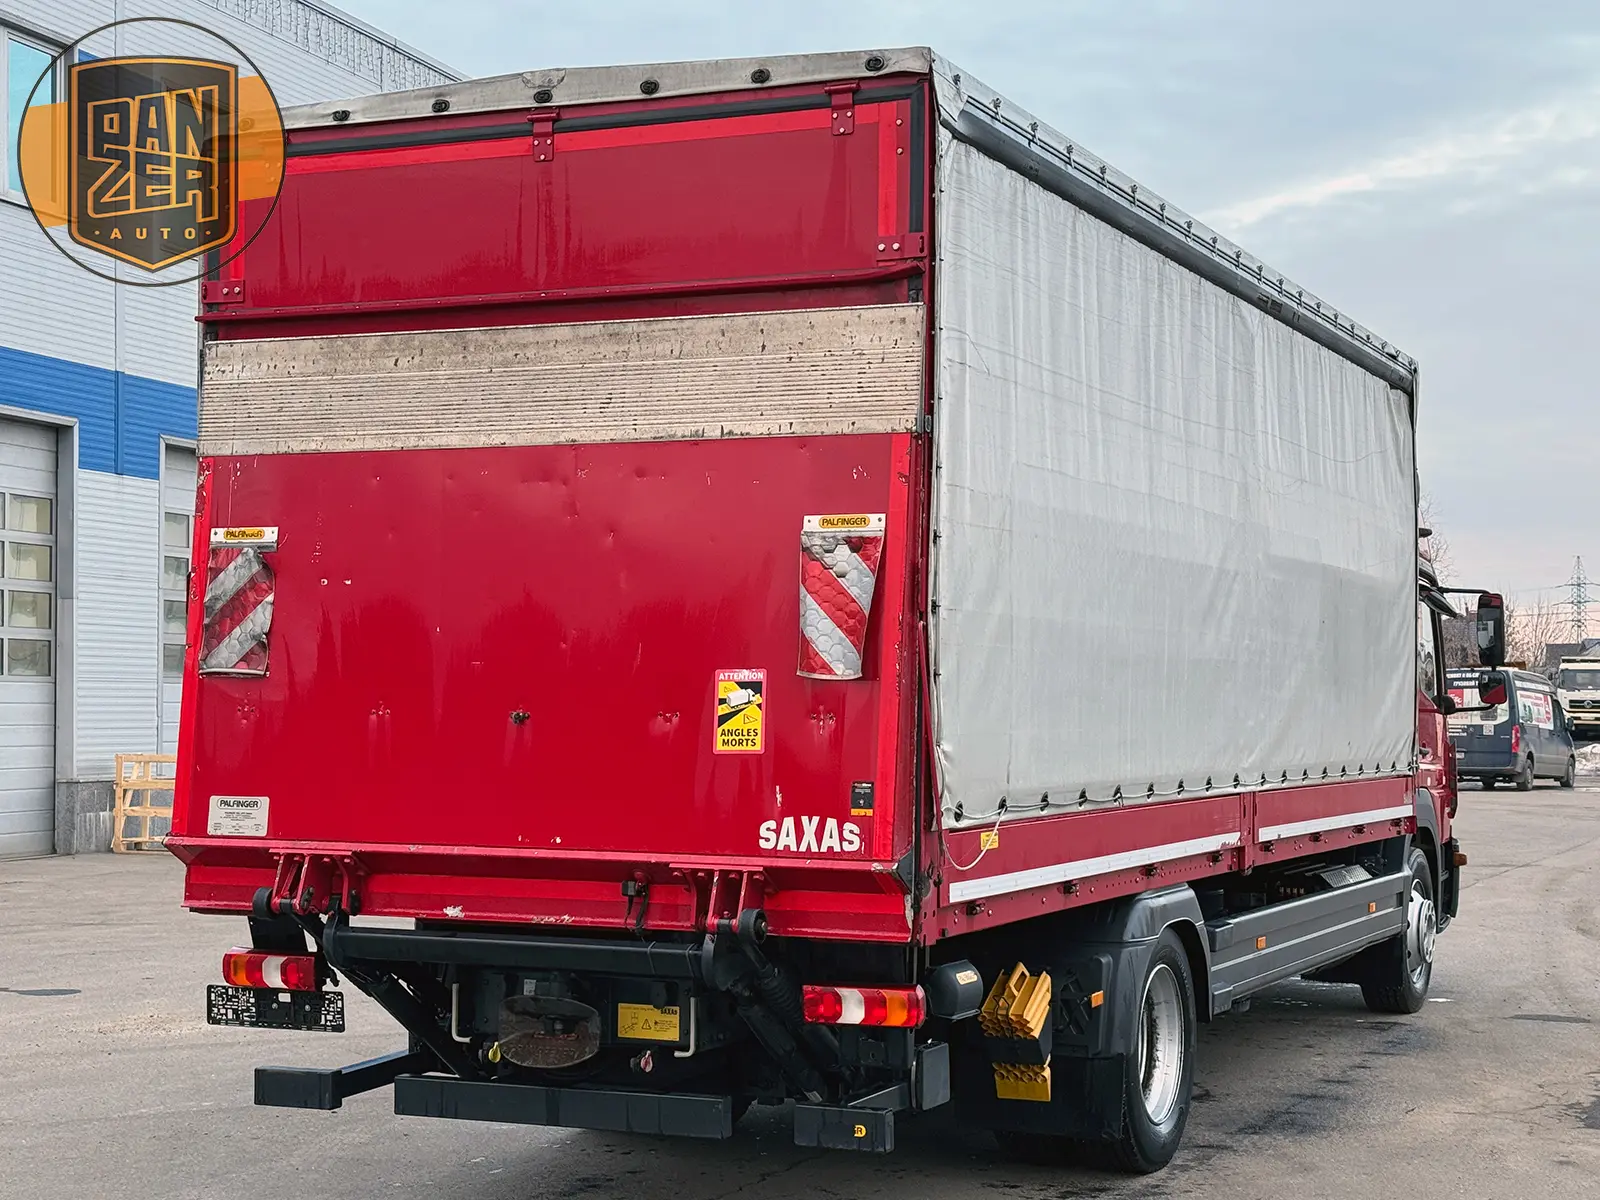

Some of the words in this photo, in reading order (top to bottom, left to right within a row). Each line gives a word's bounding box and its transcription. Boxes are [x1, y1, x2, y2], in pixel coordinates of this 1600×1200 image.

[821, 517, 867, 526] PALFINGER
[718, 672, 764, 681] ATTENTION
[720, 728, 758, 737] ANGLES
[721, 738, 757, 747] MORTS
[219, 799, 259, 808] PALFINGER
[758, 815, 861, 852] SAXAS
